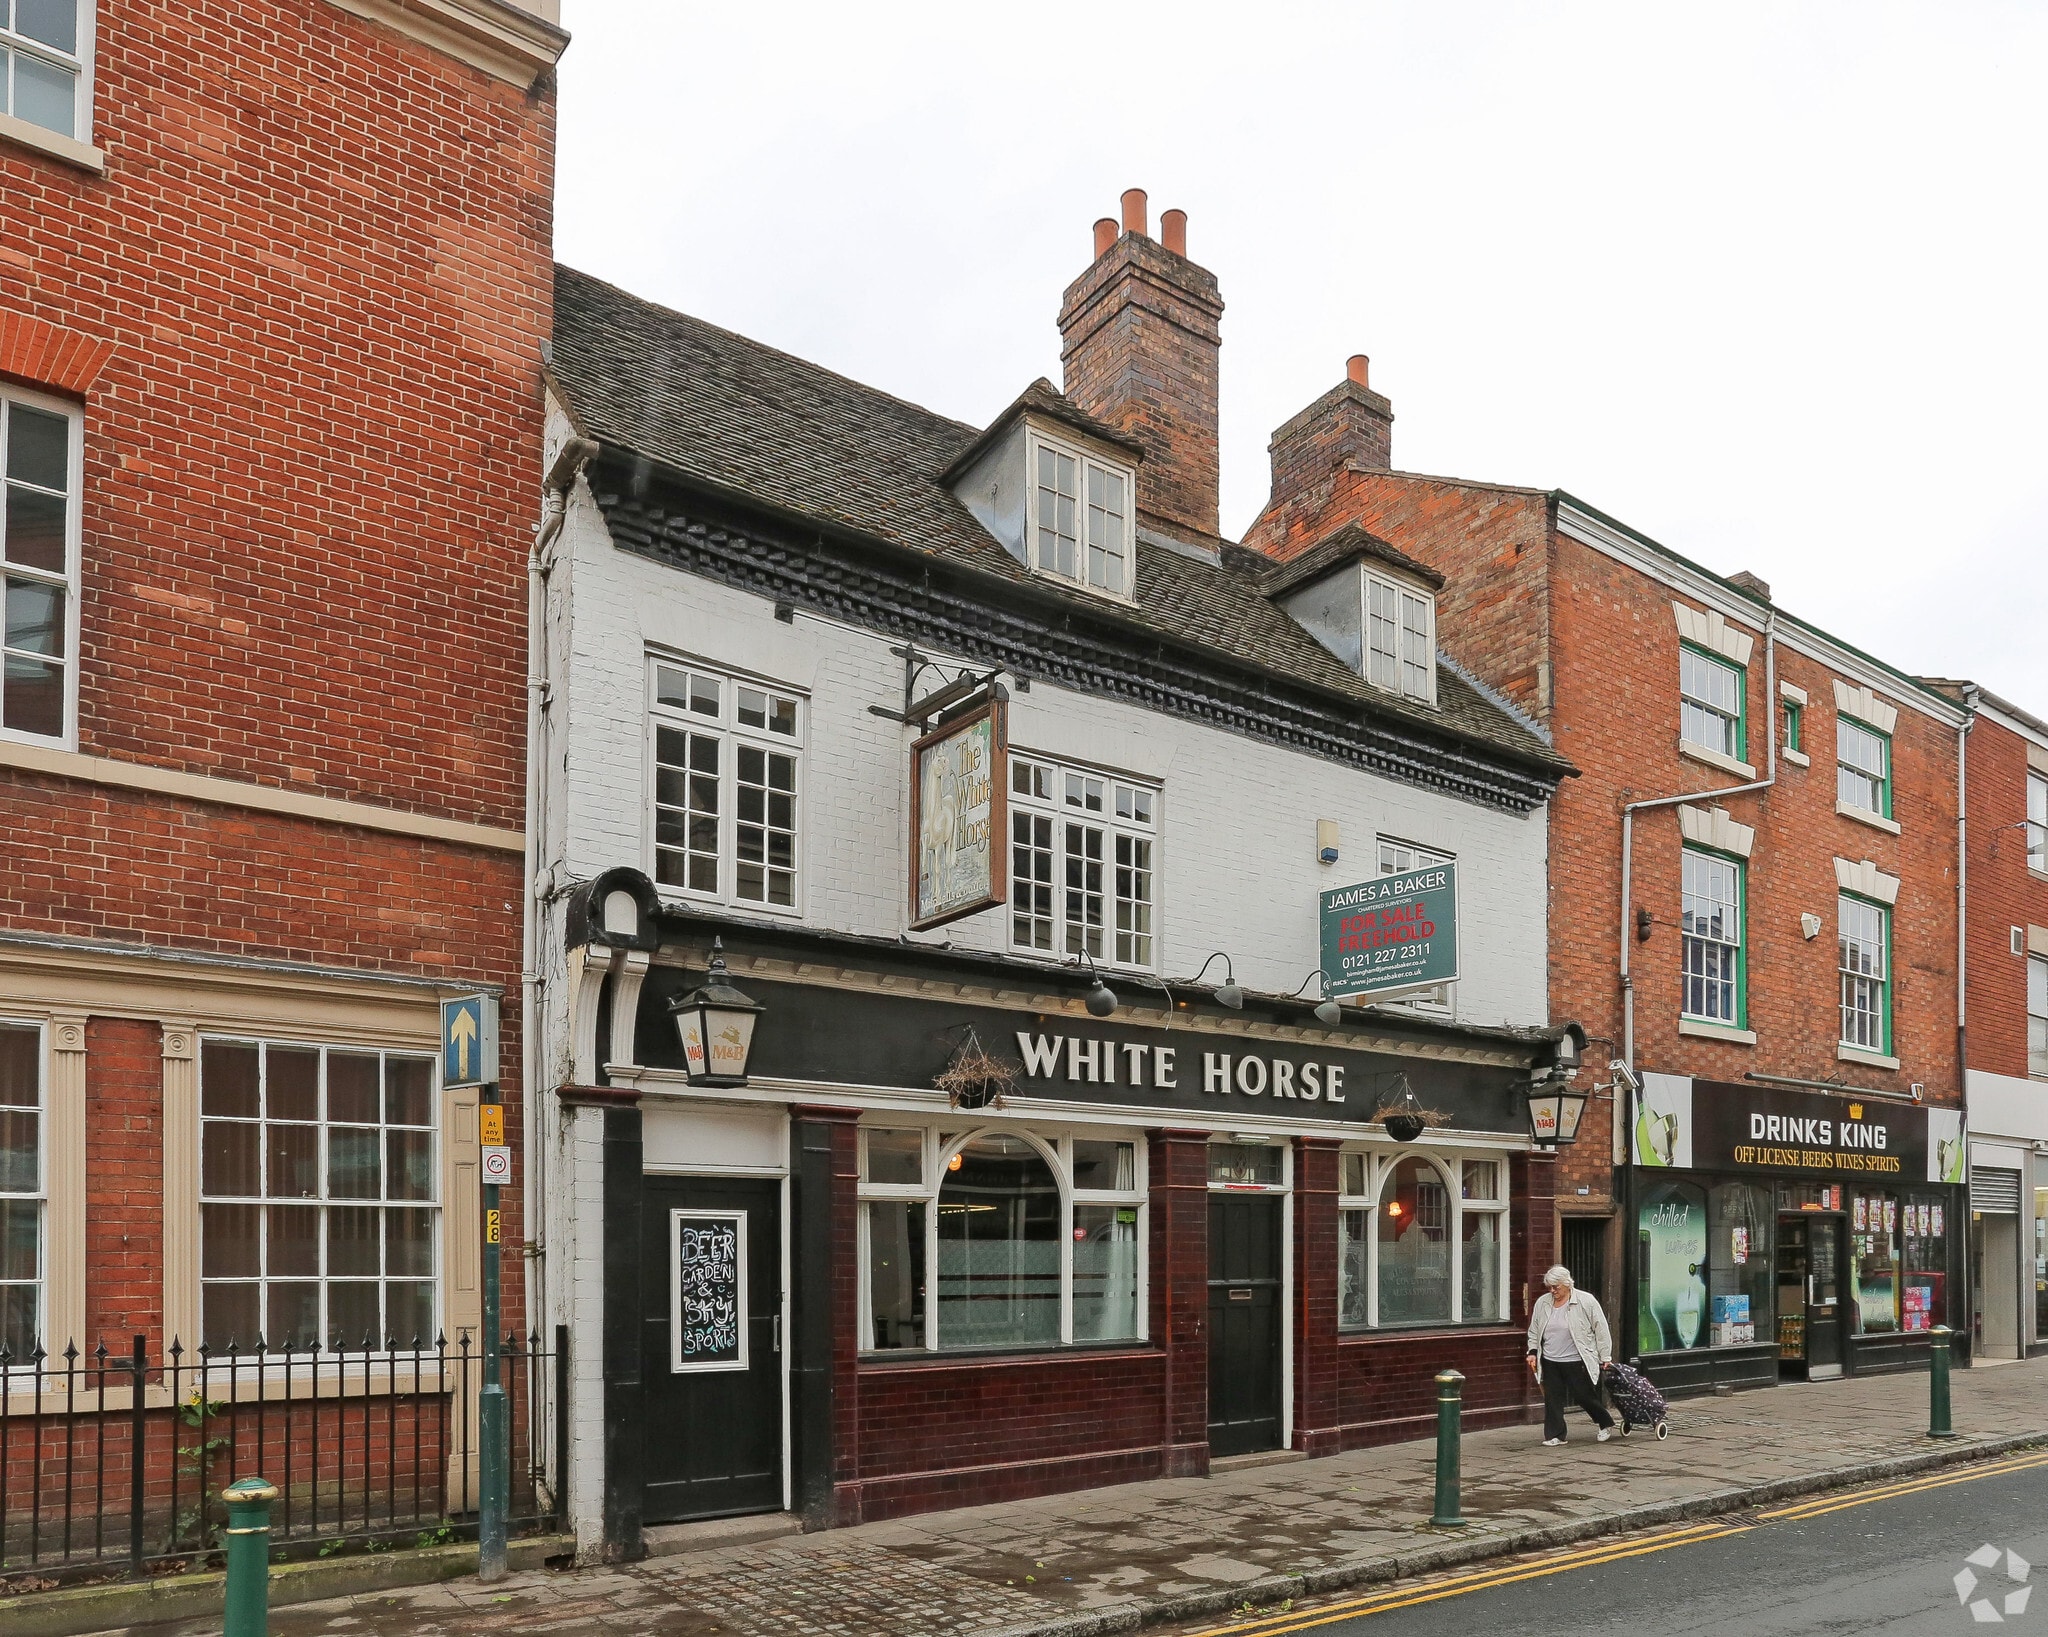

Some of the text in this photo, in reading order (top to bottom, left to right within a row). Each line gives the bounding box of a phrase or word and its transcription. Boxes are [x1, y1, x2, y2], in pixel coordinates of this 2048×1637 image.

[955, 737, 982, 778] The
[949, 769, 993, 815] White
[1327, 871, 1446, 909] JAMES A BAKER
[1357, 897, 1412, 913] CHARTERED SURVEYORS
[1341, 902, 1425, 935] FOR SALE
[1338, 921, 1436, 954] FREEHOLD
[1342, 942, 1430, 969] 0121 227 2311
[1346, 958, 1427, 978] birmingham@jamesabaker.co.uk
[1350, 968, 1422, 986] www.jamesabaker.co.uk
[712, 1044, 744, 1061] M&B
[1016, 1031, 1346, 1103] WHITE HORSE
[485, 1129, 499, 1137] any
[1536, 1118, 1555, 1129] M&B
[1751, 1113, 1887, 1150] DRINKS KING
[1734, 1145, 1900, 1172] OFF LICENSE BEERS WINES SPIRITS
[1651, 1203, 1689, 1228] chilled
[682, 1231, 735, 1262] BEER
[682, 1264, 733, 1284] GARDEN
[697, 1282, 713, 1297] &
[685, 1326, 736, 1351] SPORTS
